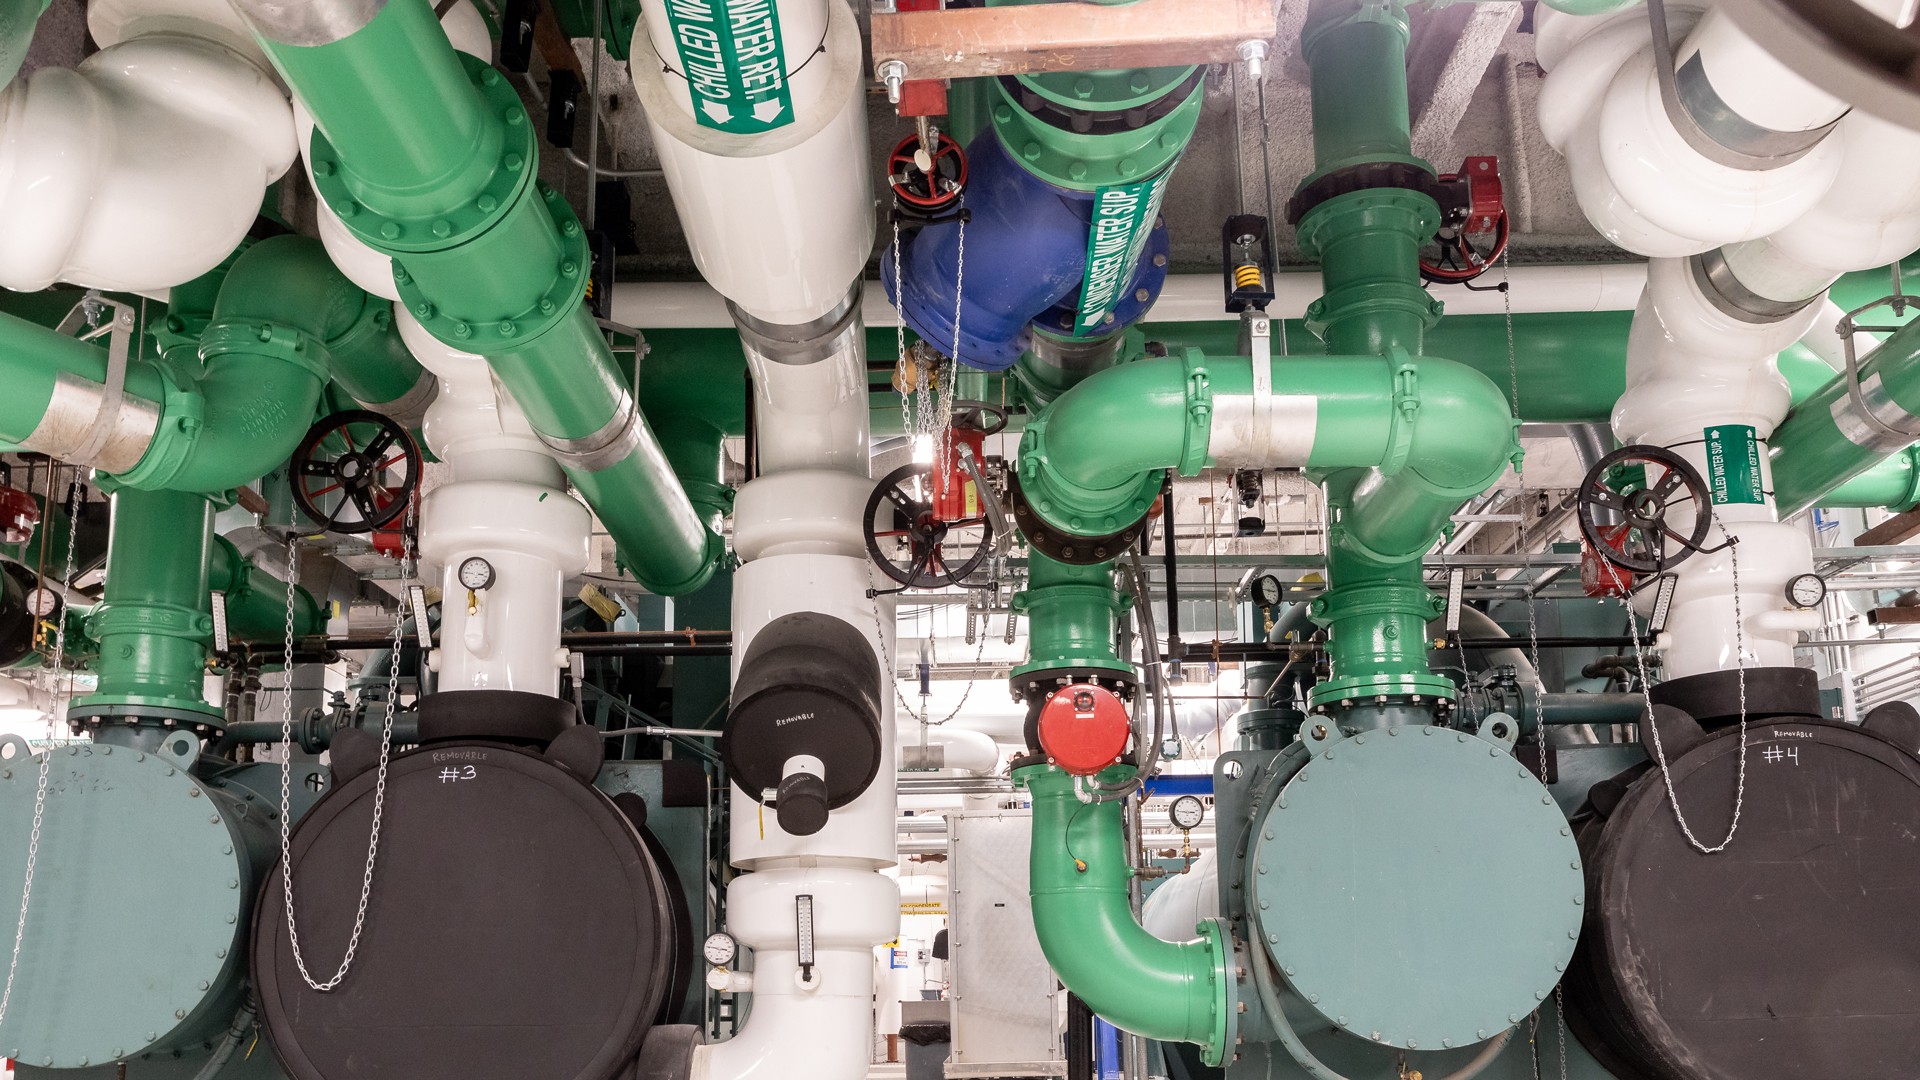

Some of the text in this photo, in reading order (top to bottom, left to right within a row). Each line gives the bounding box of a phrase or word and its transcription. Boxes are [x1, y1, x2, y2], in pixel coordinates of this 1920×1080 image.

[677, 23, 731, 99] CHILLED
[726, 0, 782, 100] WATER RET.
[1082, 187, 1141, 315] CONDENSER WATER SUP.
[1710, 440, 1728, 503] CHILLED WATER SUP.
[1746, 439, 1762, 502] CHILLED WATER SUP.
[776, 712, 815, 727] REMOVABLE
[1773, 730, 1813, 738] REMOVABLE
[432, 751, 488, 763] REMOVABLE
[438, 764, 477, 784] #3
[1762, 744, 1799, 766] #4
